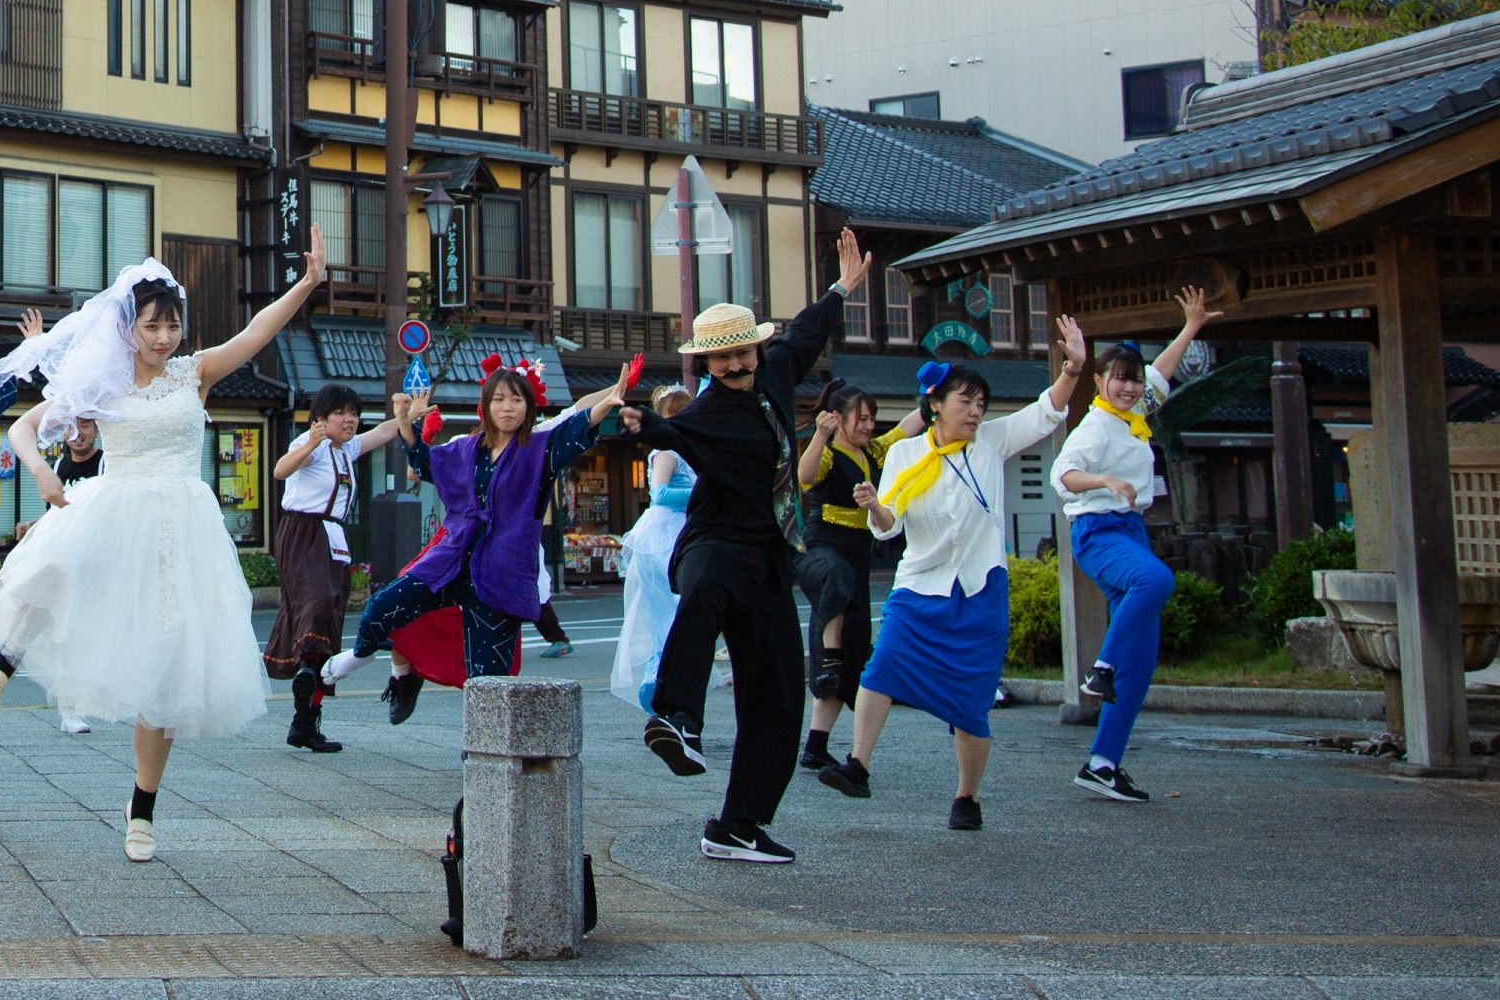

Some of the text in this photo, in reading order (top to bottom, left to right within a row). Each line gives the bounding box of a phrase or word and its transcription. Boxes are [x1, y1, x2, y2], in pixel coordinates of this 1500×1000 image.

[281, 192, 290, 245] ステーキ
[288, 178, 299, 227] 但馬牛
[0, 449, 13, 470] 氷
[243, 429, 254, 502] 生ビール
